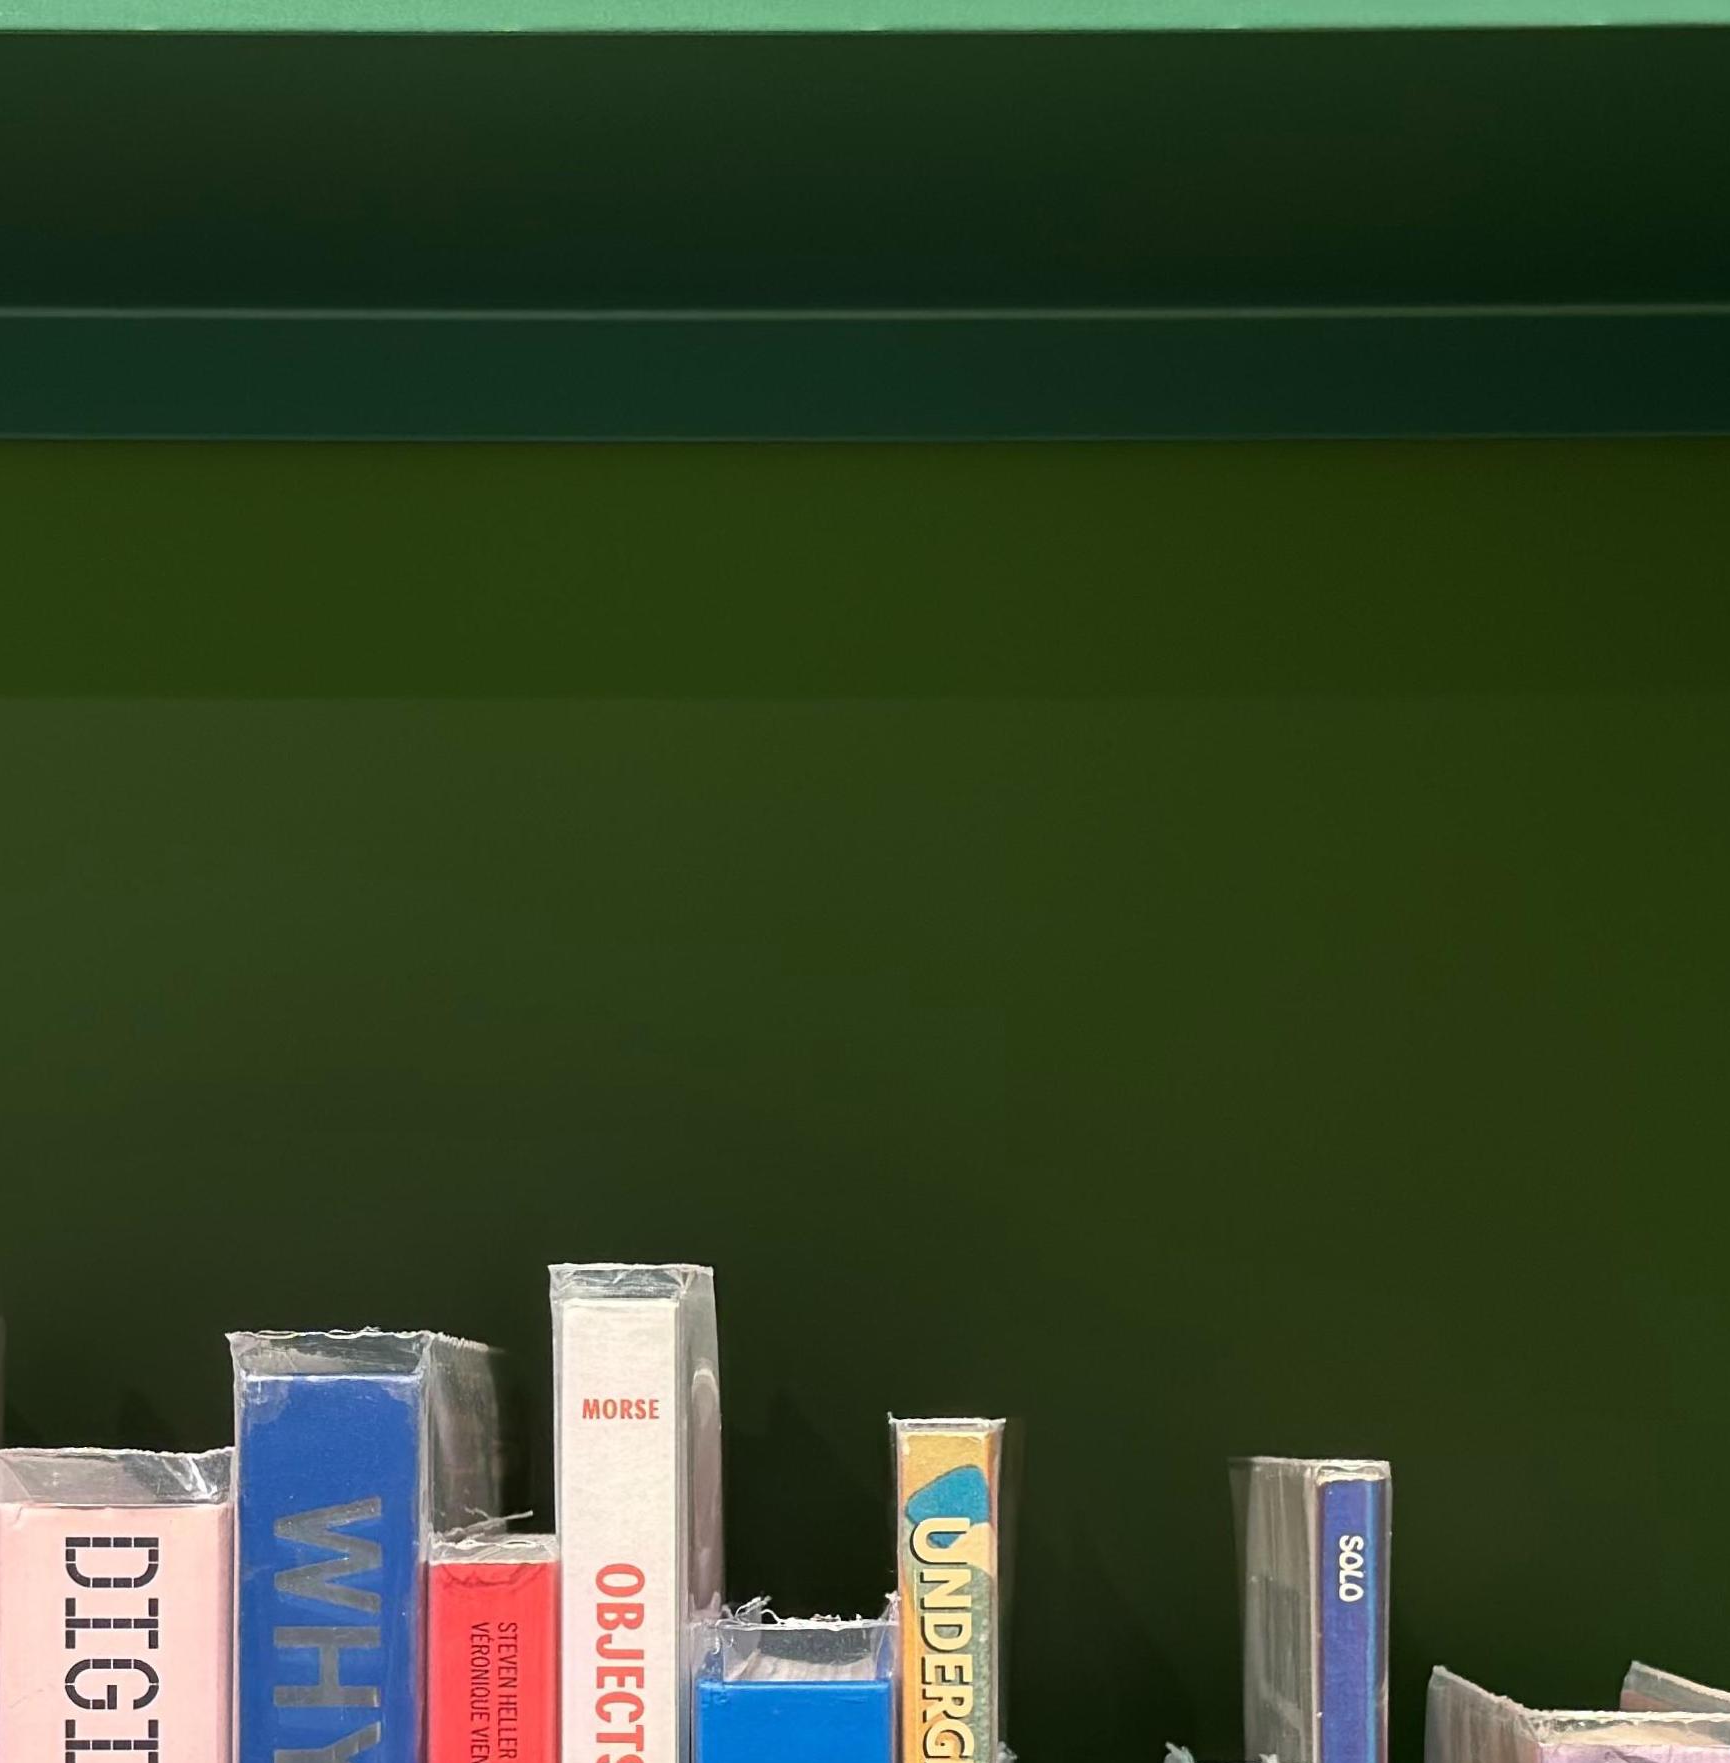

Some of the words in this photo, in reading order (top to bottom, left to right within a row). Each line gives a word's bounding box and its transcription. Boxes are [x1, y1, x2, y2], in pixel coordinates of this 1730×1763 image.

[582, 1398, 660, 1420] MORSE
[1337, 1535, 1363, 1602] SOLO
[470, 1622, 494, 1722] VÉRONIQUE
[498, 1622, 518, 1688] STEVEN
[498, 1694, 518, 1759] HELLER
